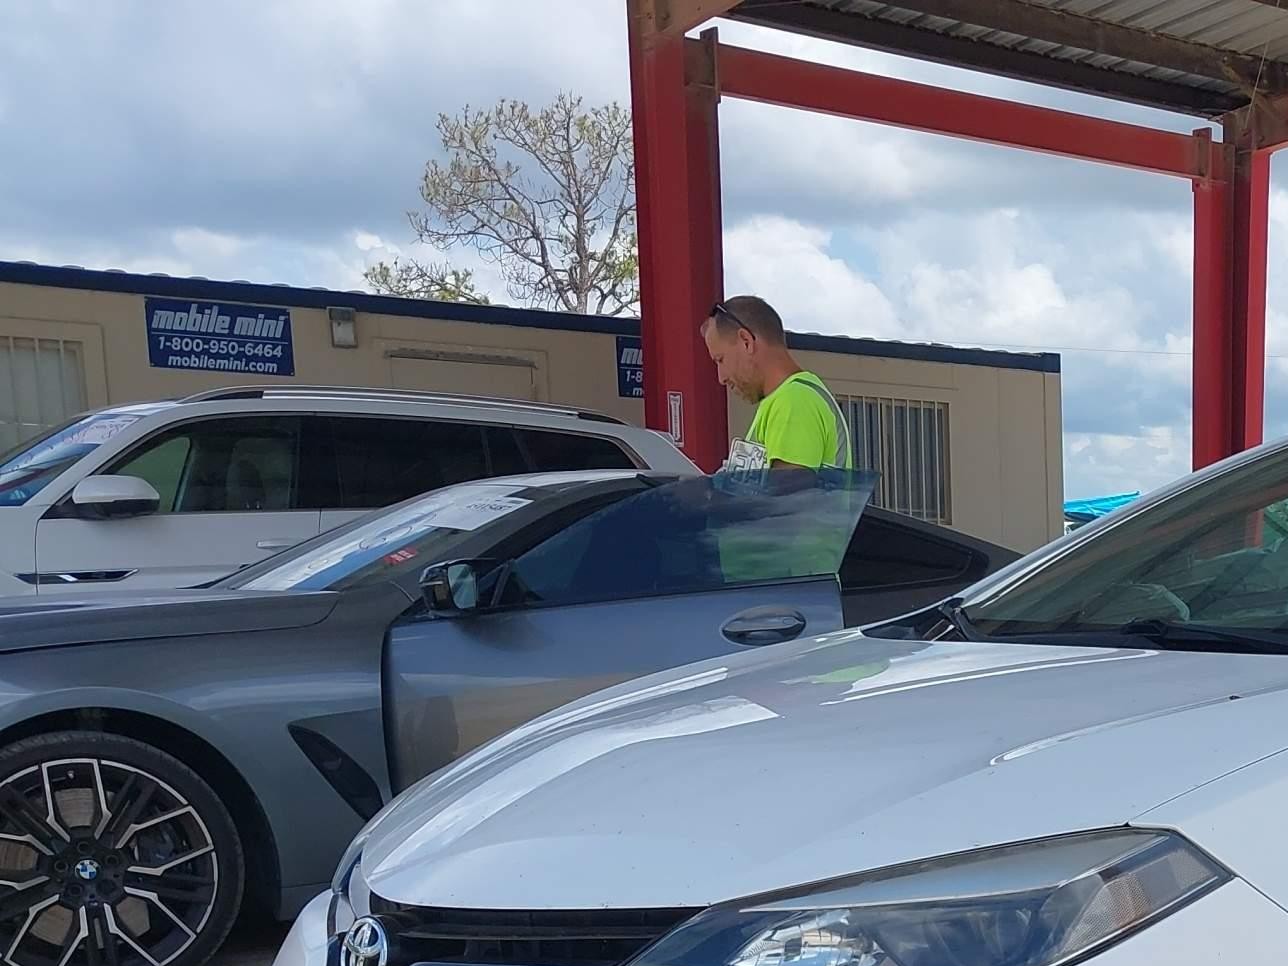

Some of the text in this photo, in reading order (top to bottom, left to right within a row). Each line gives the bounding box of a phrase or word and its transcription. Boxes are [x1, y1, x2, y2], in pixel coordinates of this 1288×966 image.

[151, 303, 285, 338] mobile mini
[158, 336, 283, 358] 1-800-950-6464
[168, 354, 278, 373] mobilemini.com
